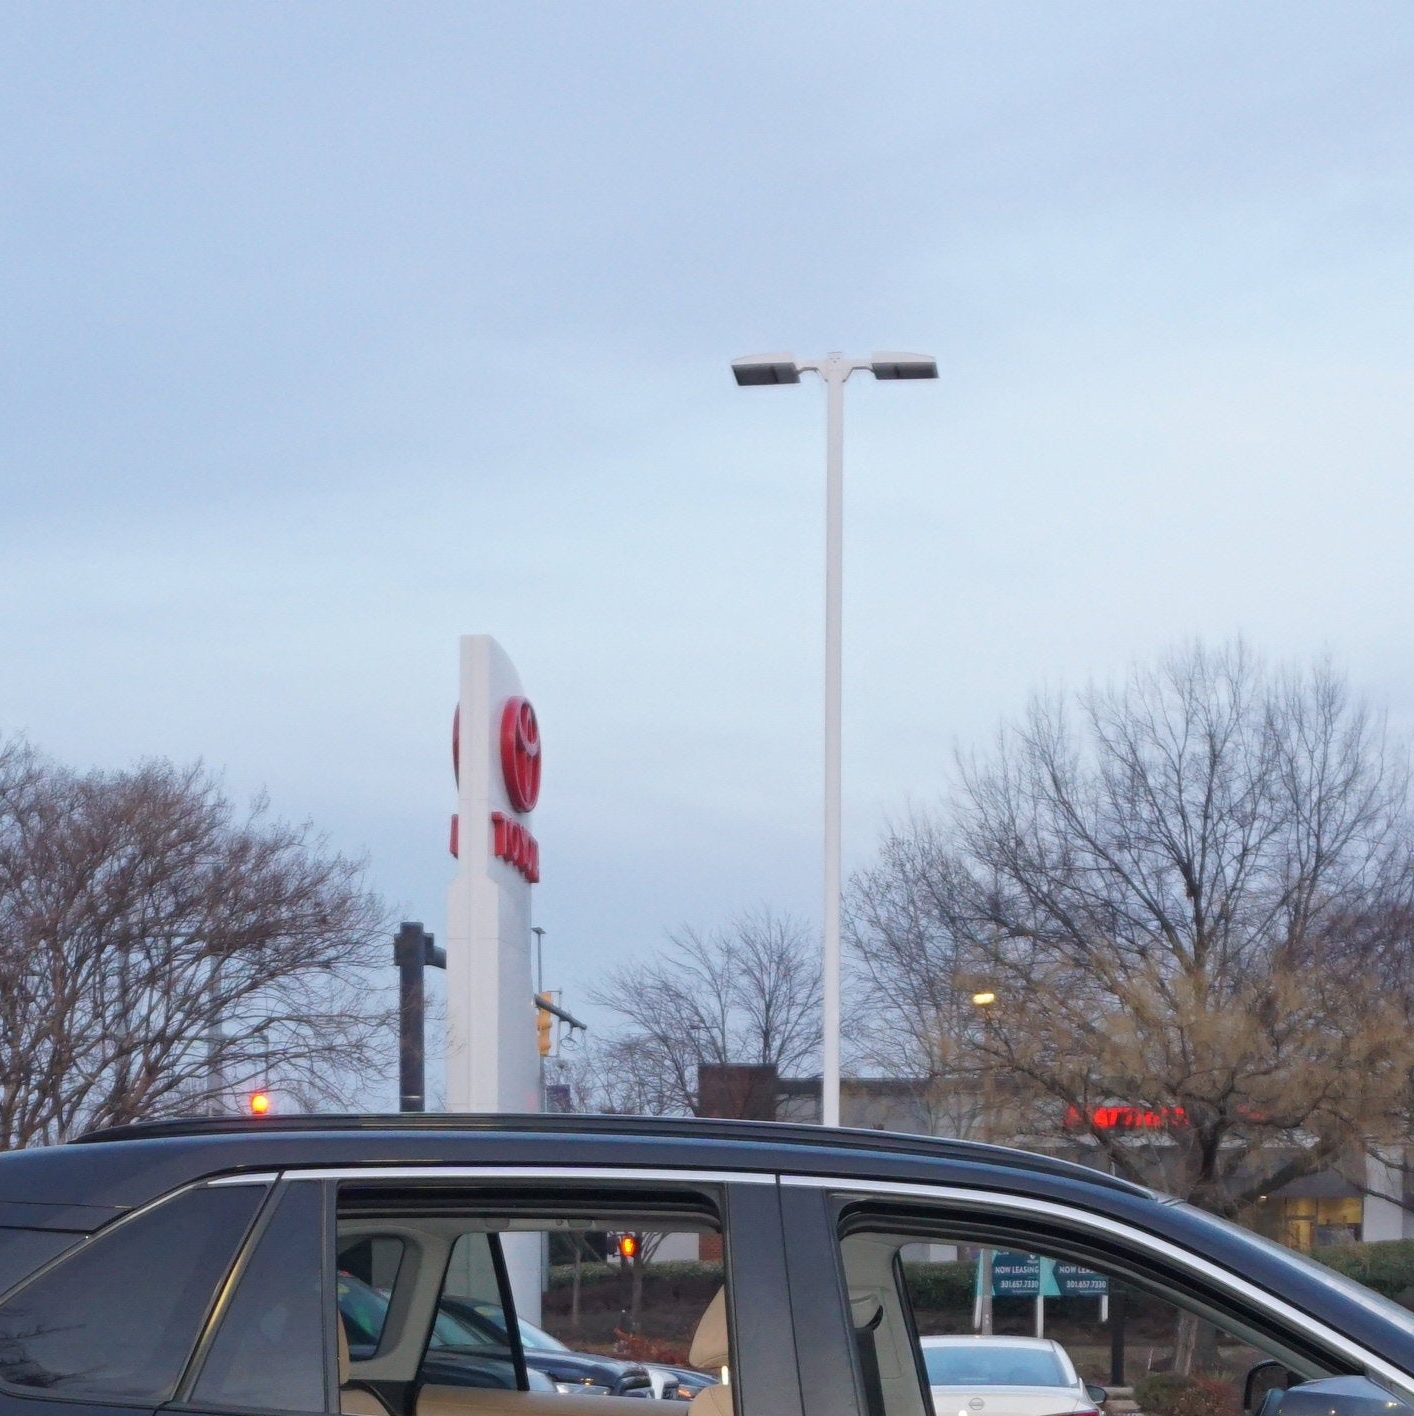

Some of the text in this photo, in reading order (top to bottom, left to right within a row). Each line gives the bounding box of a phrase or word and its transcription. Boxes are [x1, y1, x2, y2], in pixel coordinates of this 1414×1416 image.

[995, 1265, 1040, 1274] NOW LEASING
[1059, 1265, 1077, 1274] NOW
